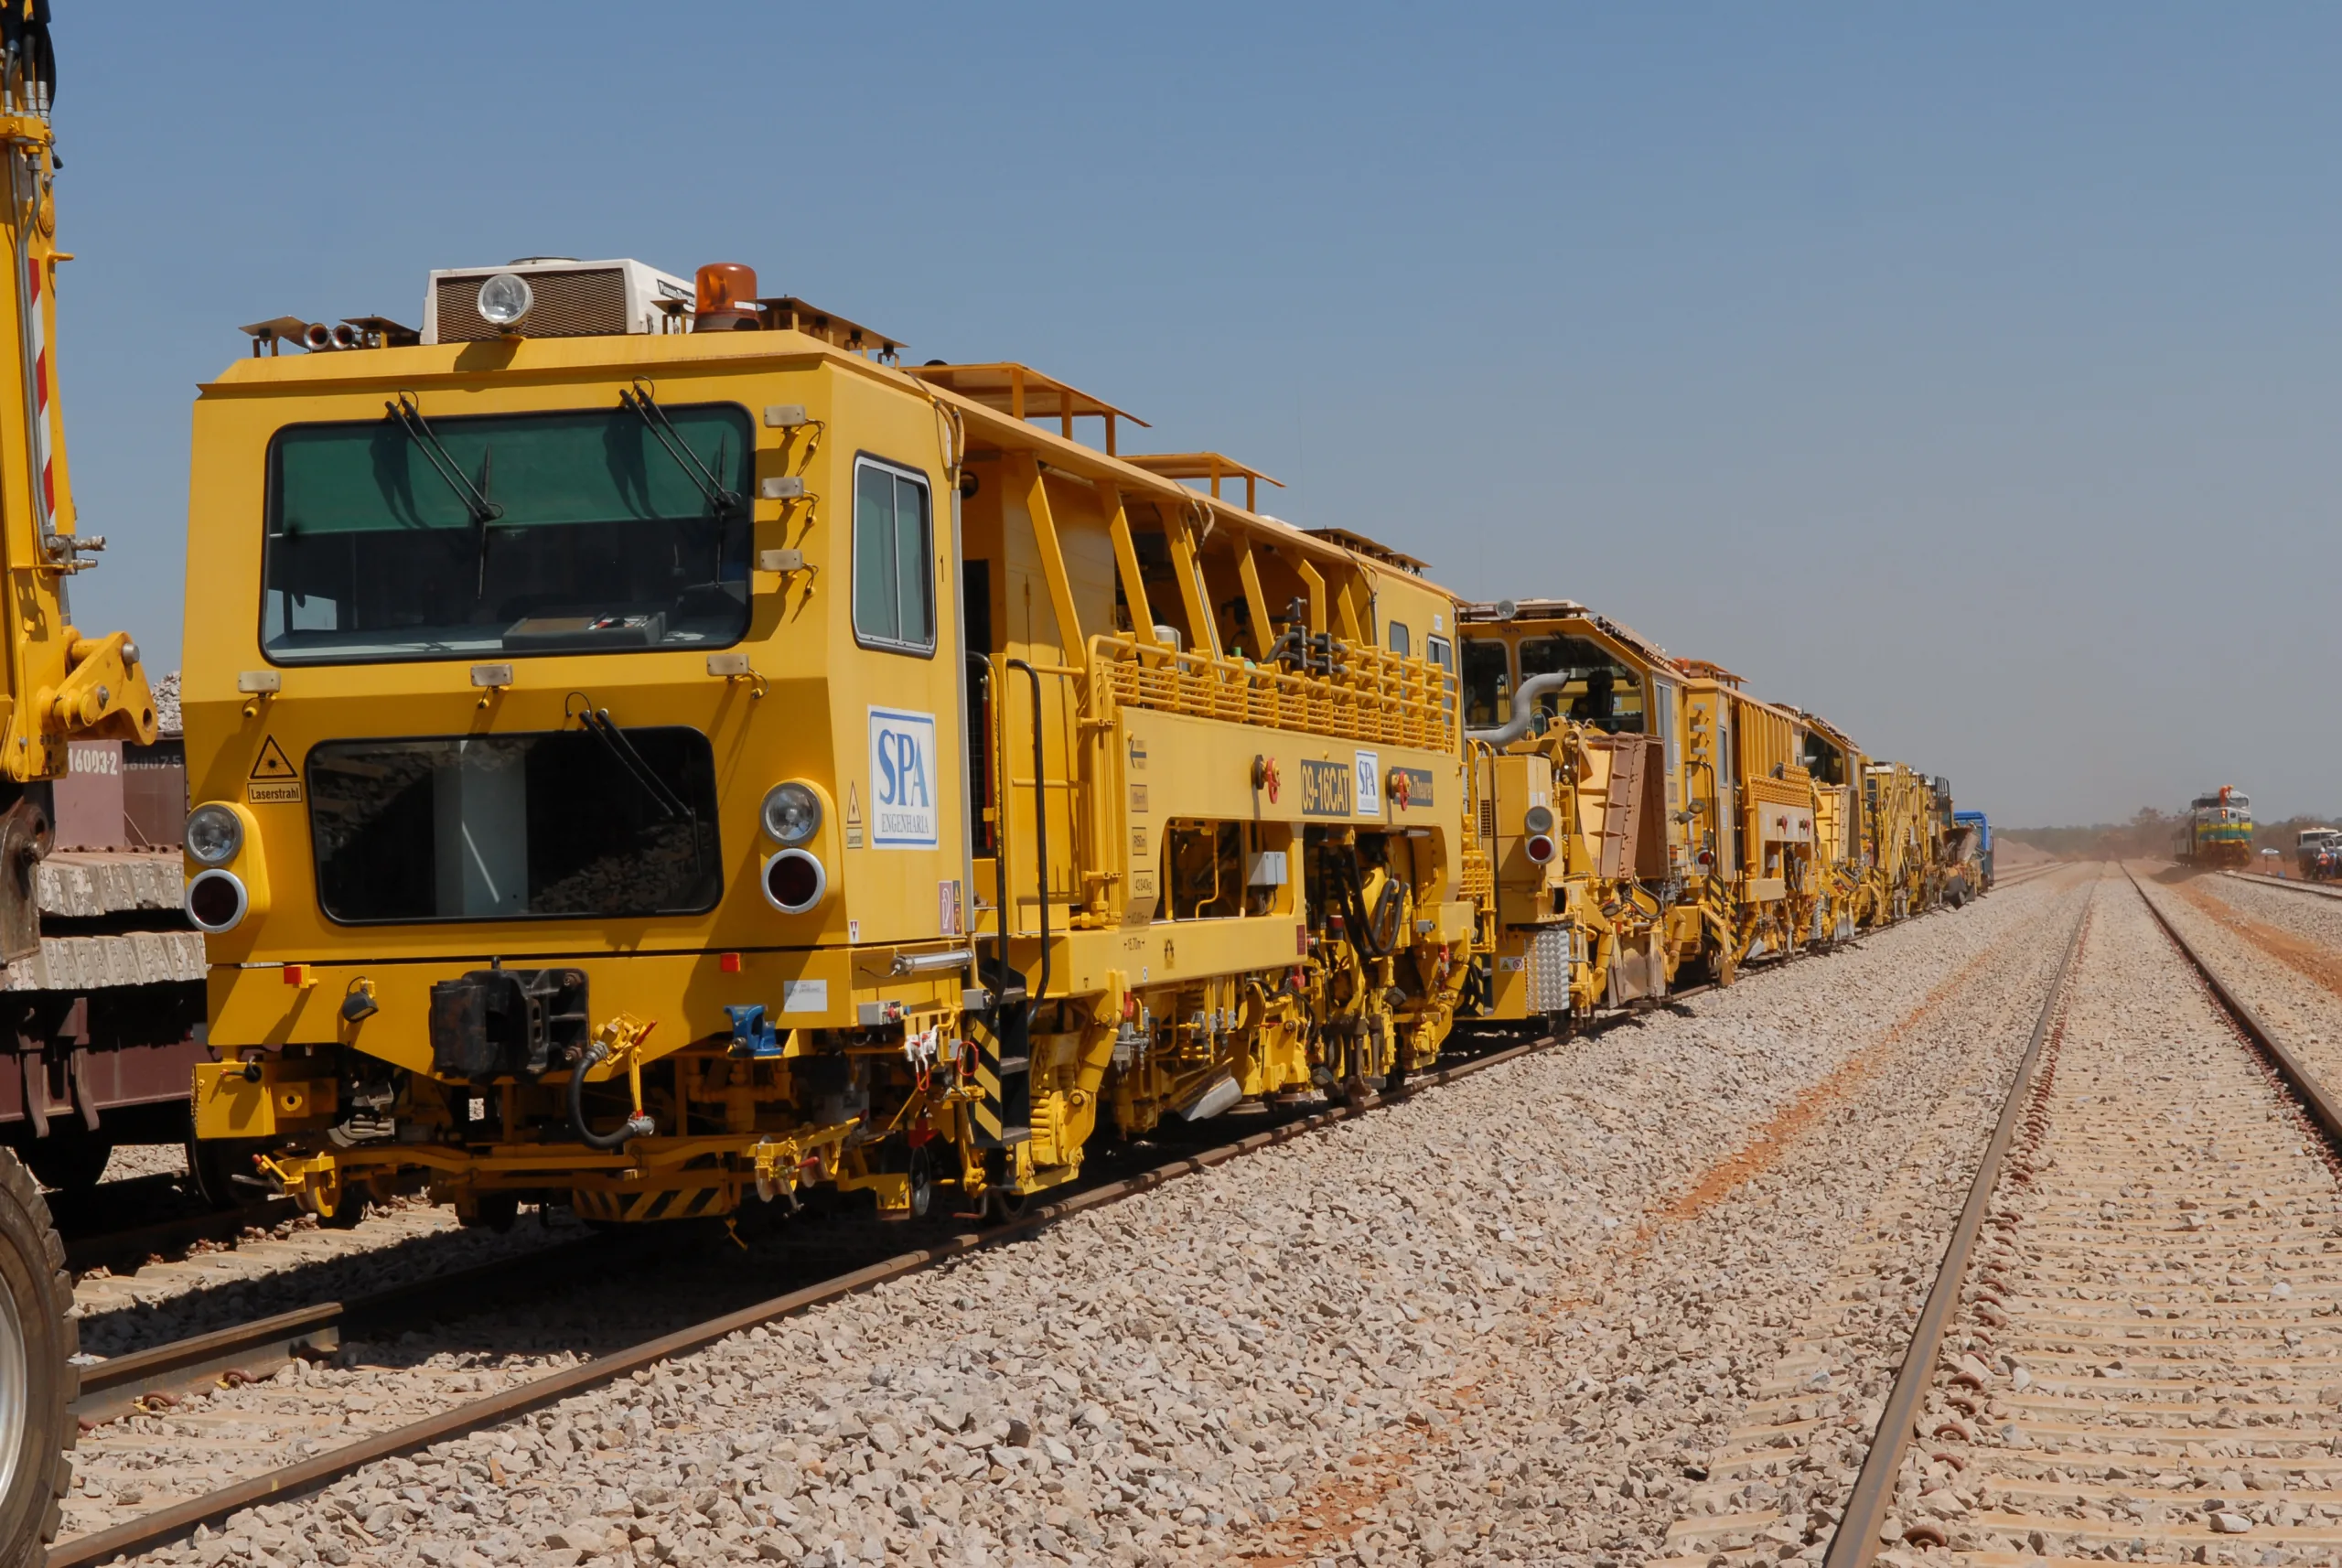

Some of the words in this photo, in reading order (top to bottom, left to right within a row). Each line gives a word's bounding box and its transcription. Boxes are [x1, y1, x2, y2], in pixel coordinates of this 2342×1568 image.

[878, 728, 929, 808] SPA
[1359, 760, 1376, 796] SPA
[251, 788, 299, 800] Laserstrahl
[1301, 764, 1348, 812] 09-16CAT
[881, 813, 929, 834] ENGENHARIA
